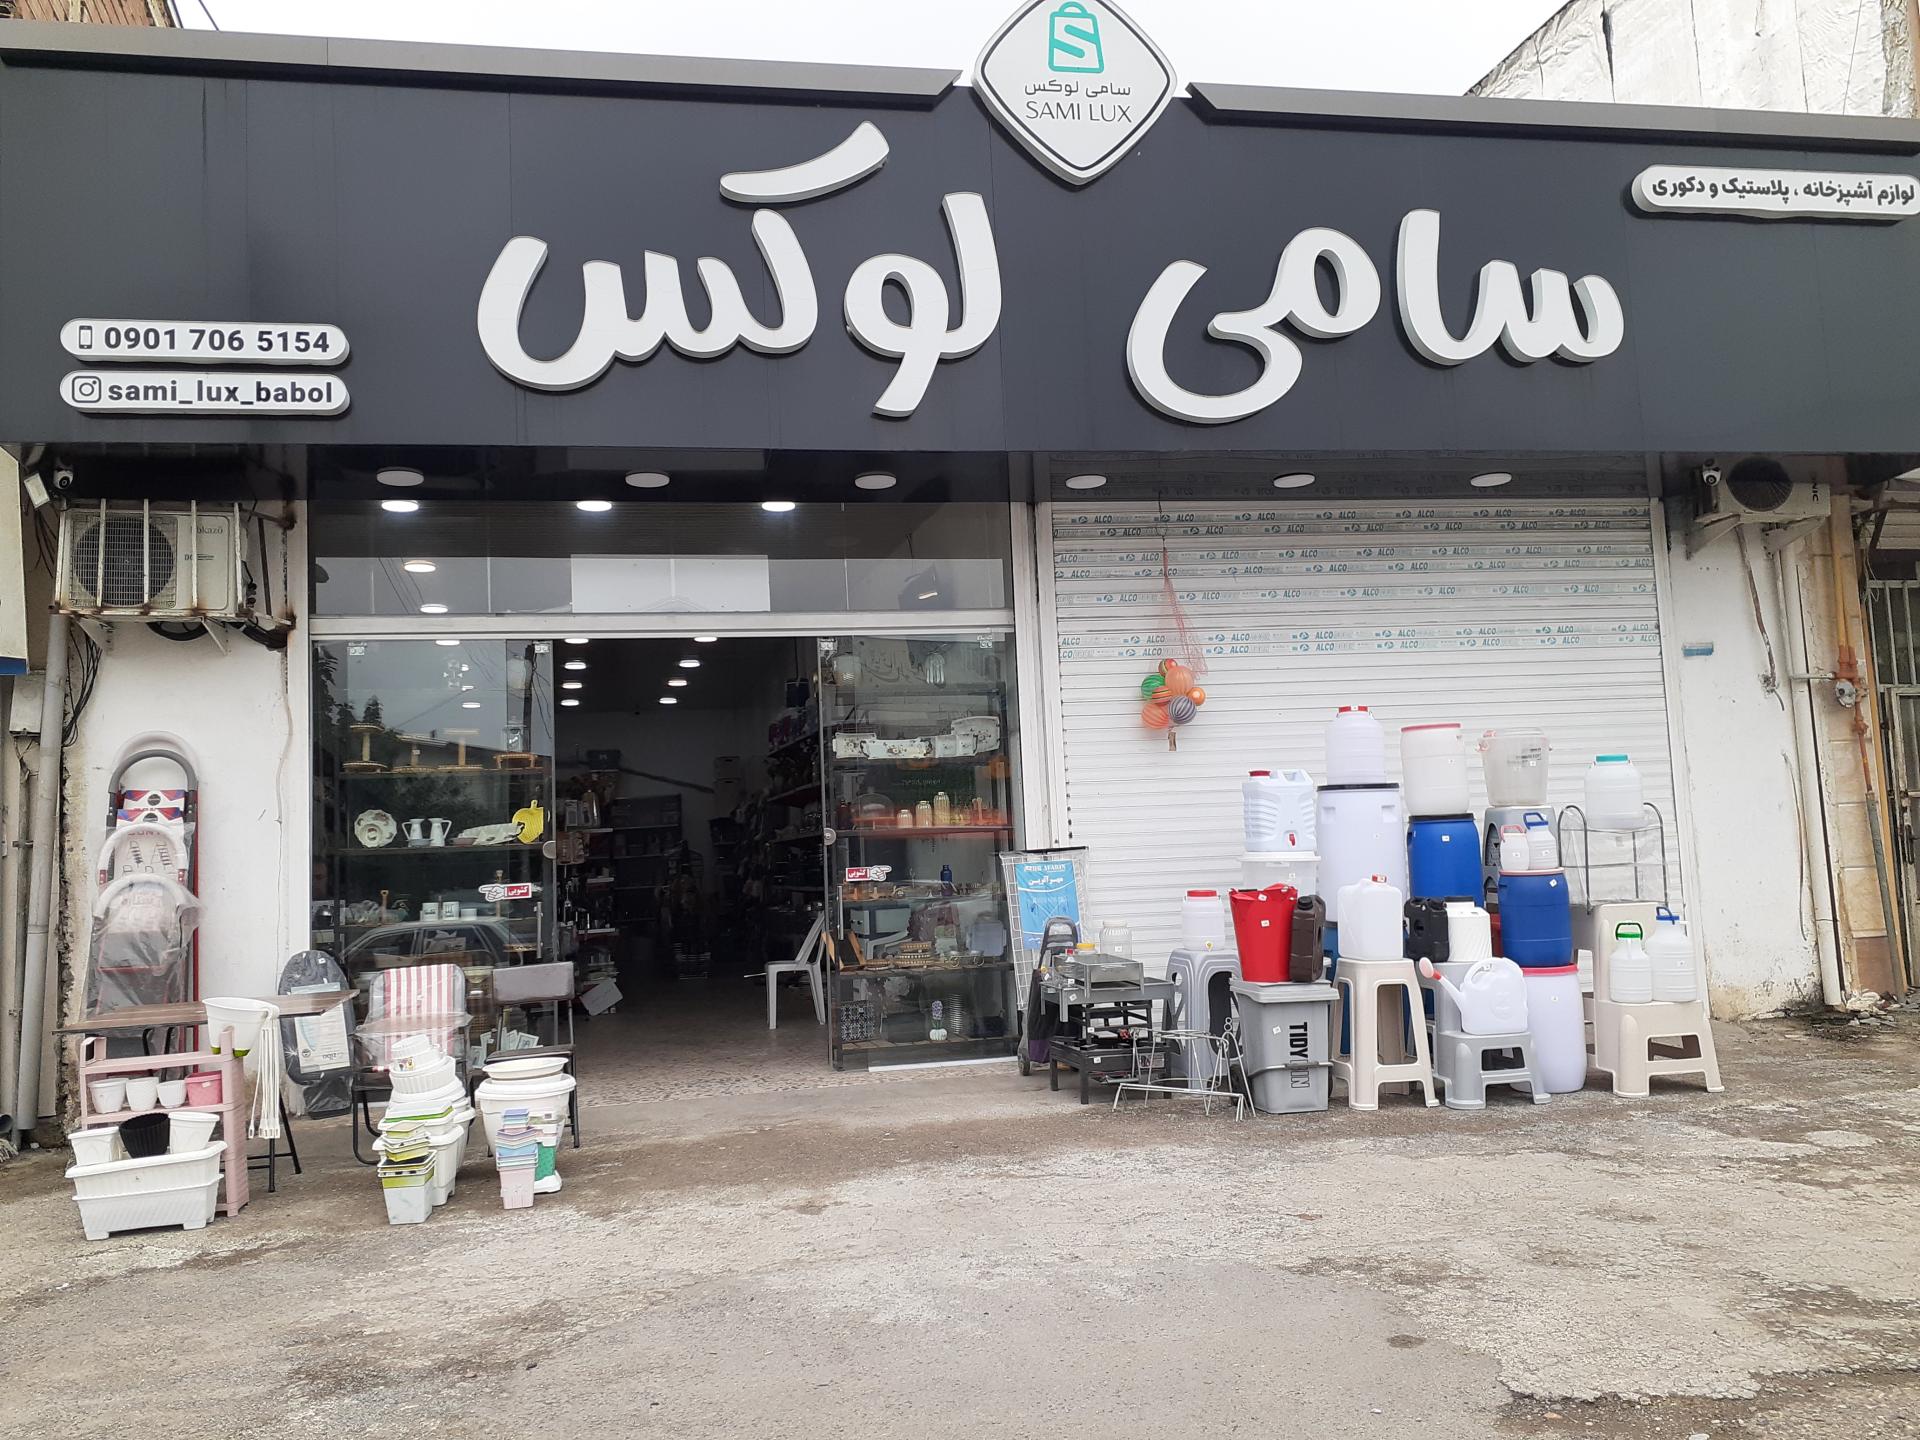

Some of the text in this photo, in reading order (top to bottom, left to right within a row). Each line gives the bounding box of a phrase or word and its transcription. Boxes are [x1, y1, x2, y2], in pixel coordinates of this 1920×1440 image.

[1024, 79, 1131, 98] سامی لوکس
[1026, 101, 1132, 123] SAMI LUX
[1652, 176, 1705, 198] دکوری
[1710, 182, 1718, 199] و
[1721, 178, 1790, 204] پلاستیک
[1876, 184, 1915, 206] لوازم
[477, 120, 1624, 424] سامی لوکس
[104, 327, 330, 353] 0901 706 5154
[108, 380, 332, 405] sami_lux_babol
[1094, 508, 1586, 524] ALCO ALCO ALCO ALCO ALCO ALCO ALCO
[1122, 520, 1610, 536] ALCO ALCO ALCO ALCO ALCO ALCO ALCO
[1059, 546, 1612, 563] ALCO ALCO ALCO ALCO ALCO ALCO ALCO ALCO
[1070, 559, 1650, 578] ALCO ALCO ALCO ALCO ALCO ALCO ALCO ALCO
[1119, 584, 1600, 602] ALCO ALCO ALCO ALCO ALCO ALCO ALCO
[1060, 634, 1657, 658] LCO ALCO ALCO ALCO ALCO ALCO ALCO ALCO
[1061, 624, 1649, 646] ALCO ALCO ALCO ALCO ALCO ALCO ALCO ALCO
[1290, 1022, 1308, 1058] TIDY
